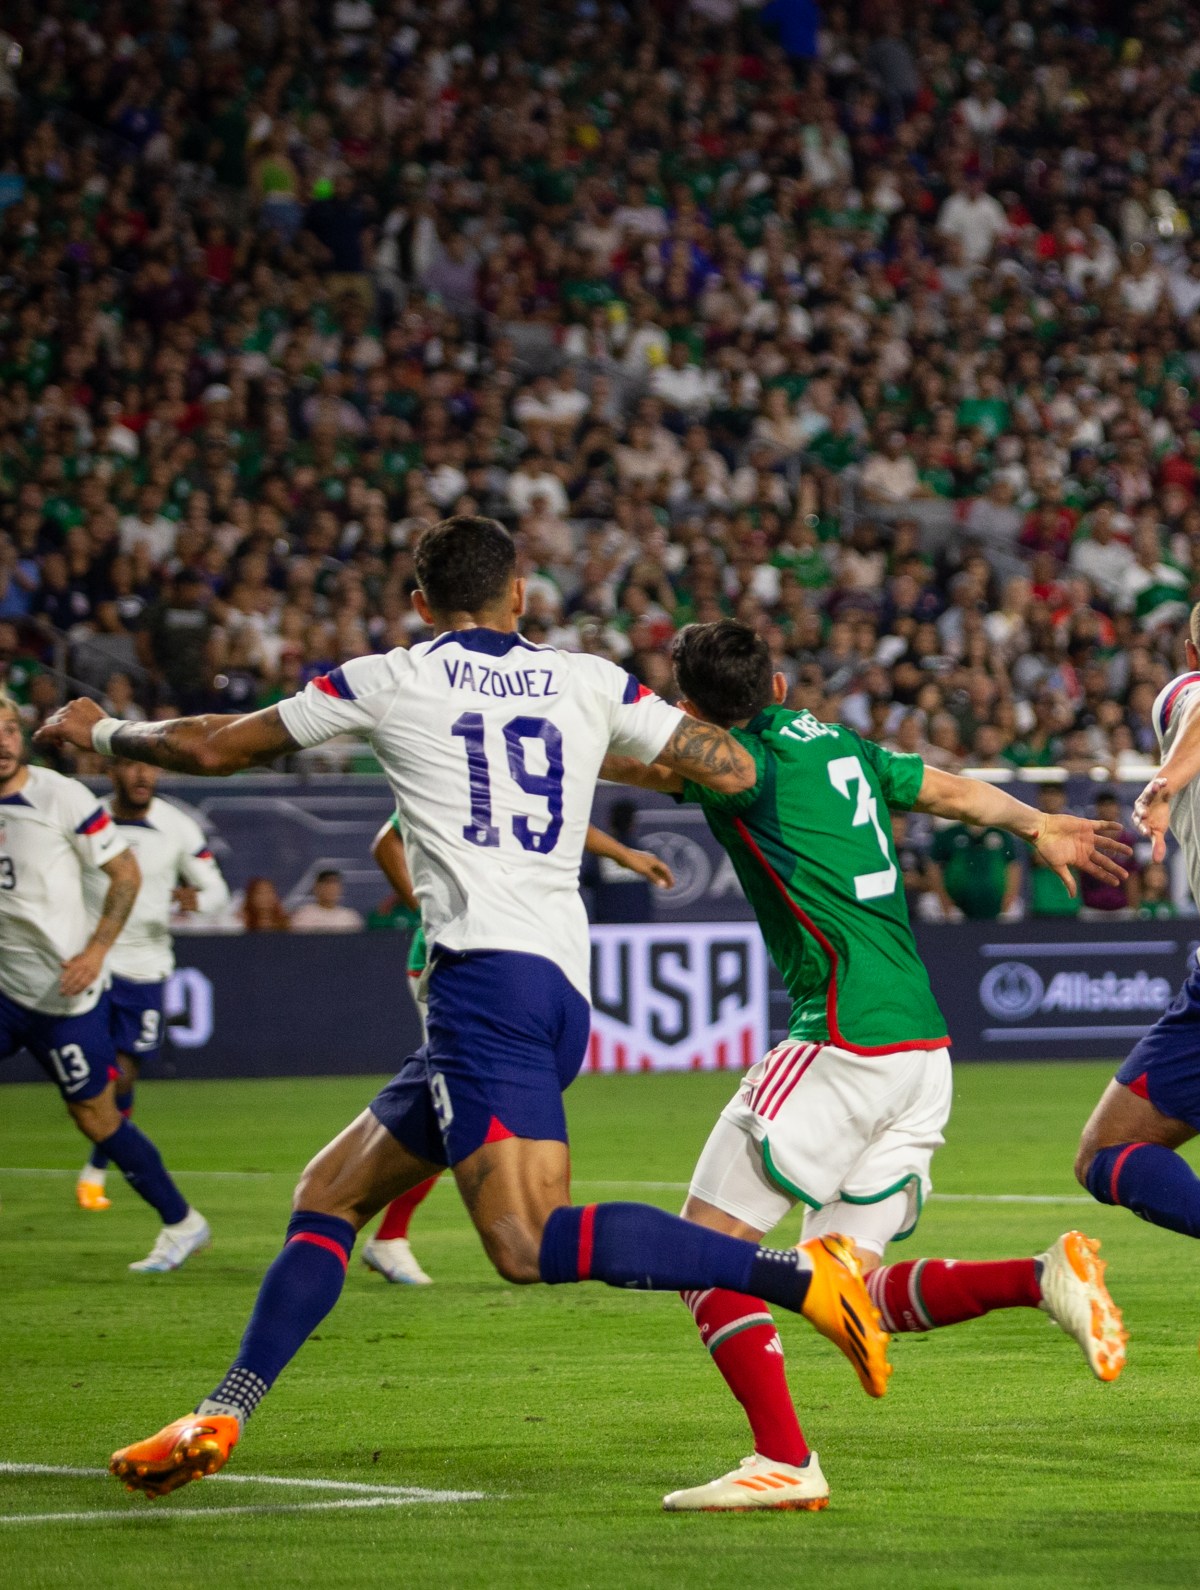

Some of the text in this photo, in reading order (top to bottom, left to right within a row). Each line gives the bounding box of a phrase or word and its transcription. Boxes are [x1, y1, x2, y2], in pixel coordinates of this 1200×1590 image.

[443, 659, 558, 698] VAZQUEZ
[451, 711, 565, 855] 19
[827, 755, 898, 900] 3
[591, 942, 750, 1046] USA
[1041, 971, 1172, 1012] Allstate
[51, 1043, 91, 1083] 13
